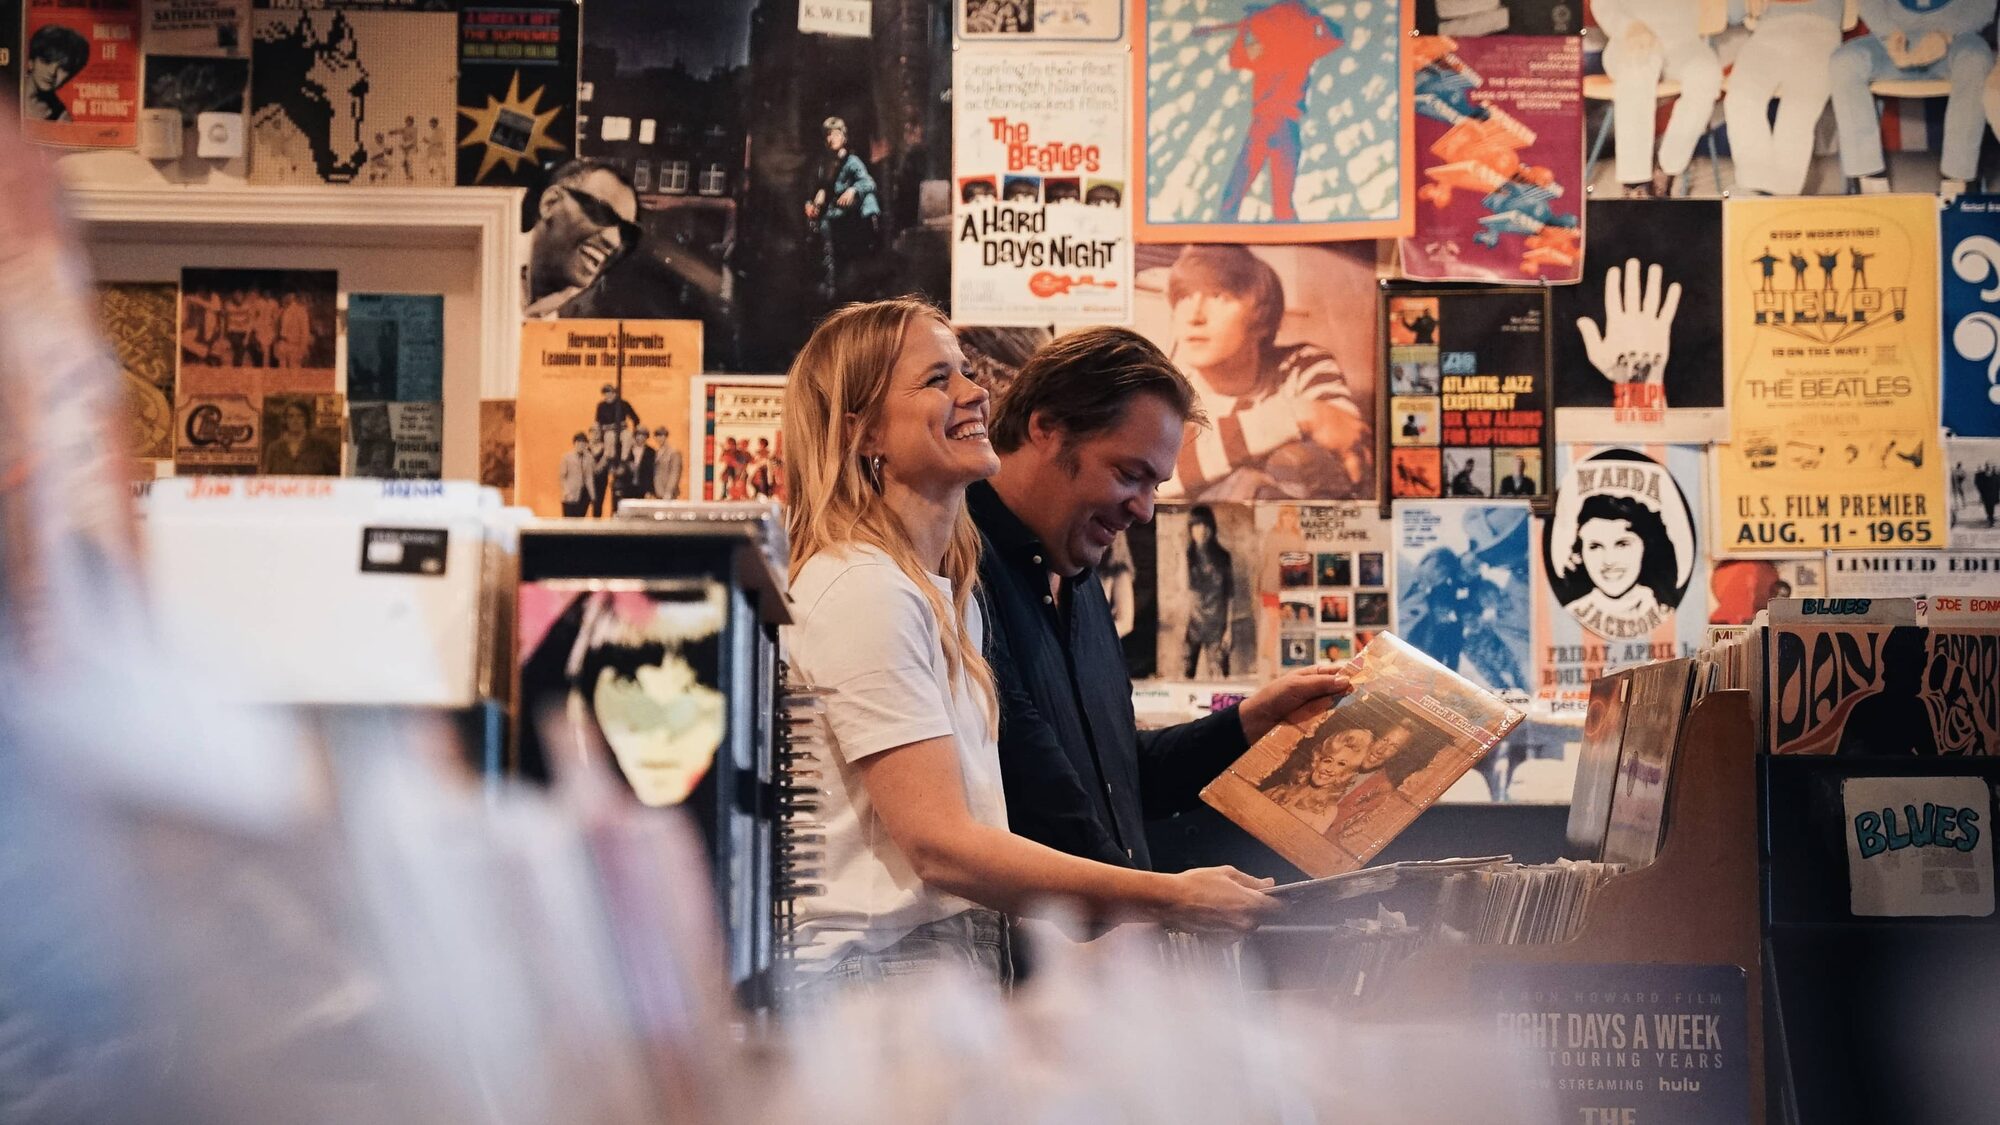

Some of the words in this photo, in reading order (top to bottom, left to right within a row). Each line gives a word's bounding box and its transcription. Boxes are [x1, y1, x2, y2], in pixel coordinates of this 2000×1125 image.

[988, 115, 1029, 144] The
[1754, 287, 1907, 324] HELP!
[1442, 376, 1499, 393] ATLANTIC
[1502, 376, 1533, 393] JAZZ
[1746, 378, 1794, 399] THE
[1800, 376, 1912, 399] BEATLES
[1443, 393, 1516, 410] EXCITEMENT
[1577, 465, 1662, 502] WANDA
[1786, 494, 1829, 517] FILM
[1840, 493, 1927, 517] PREMIER
[1736, 522, 1805, 543] AUG.
[1820, 523, 1841, 543] 11
[1867, 521, 1932, 543] 1965
[1836, 557, 1936, 572] LIMITED
[1801, 597, 1872, 615] BLUES
[1935, 598, 1962, 612] JOE
[1574, 602, 1662, 638] JACKSON
[1623, 642, 1676, 661] APRIL
[1854, 802, 1980, 859] BLUES
[1575, 991, 1659, 1004] HOWARD
[1675, 992, 1721, 1005] FILM
[1567, 1012, 1626, 1050] DAYS
[1632, 1013, 1649, 1049] A
[1654, 1013, 1722, 1050] WEEK
[1549, 1051, 1641, 1068] TOURING
[1655, 1052, 1723, 1068] YEARS
[1558, 1078, 1644, 1091] STREAMING
[1658, 1076, 1700, 1092] hulu
[1579, 1106, 1637, 1125] THE
